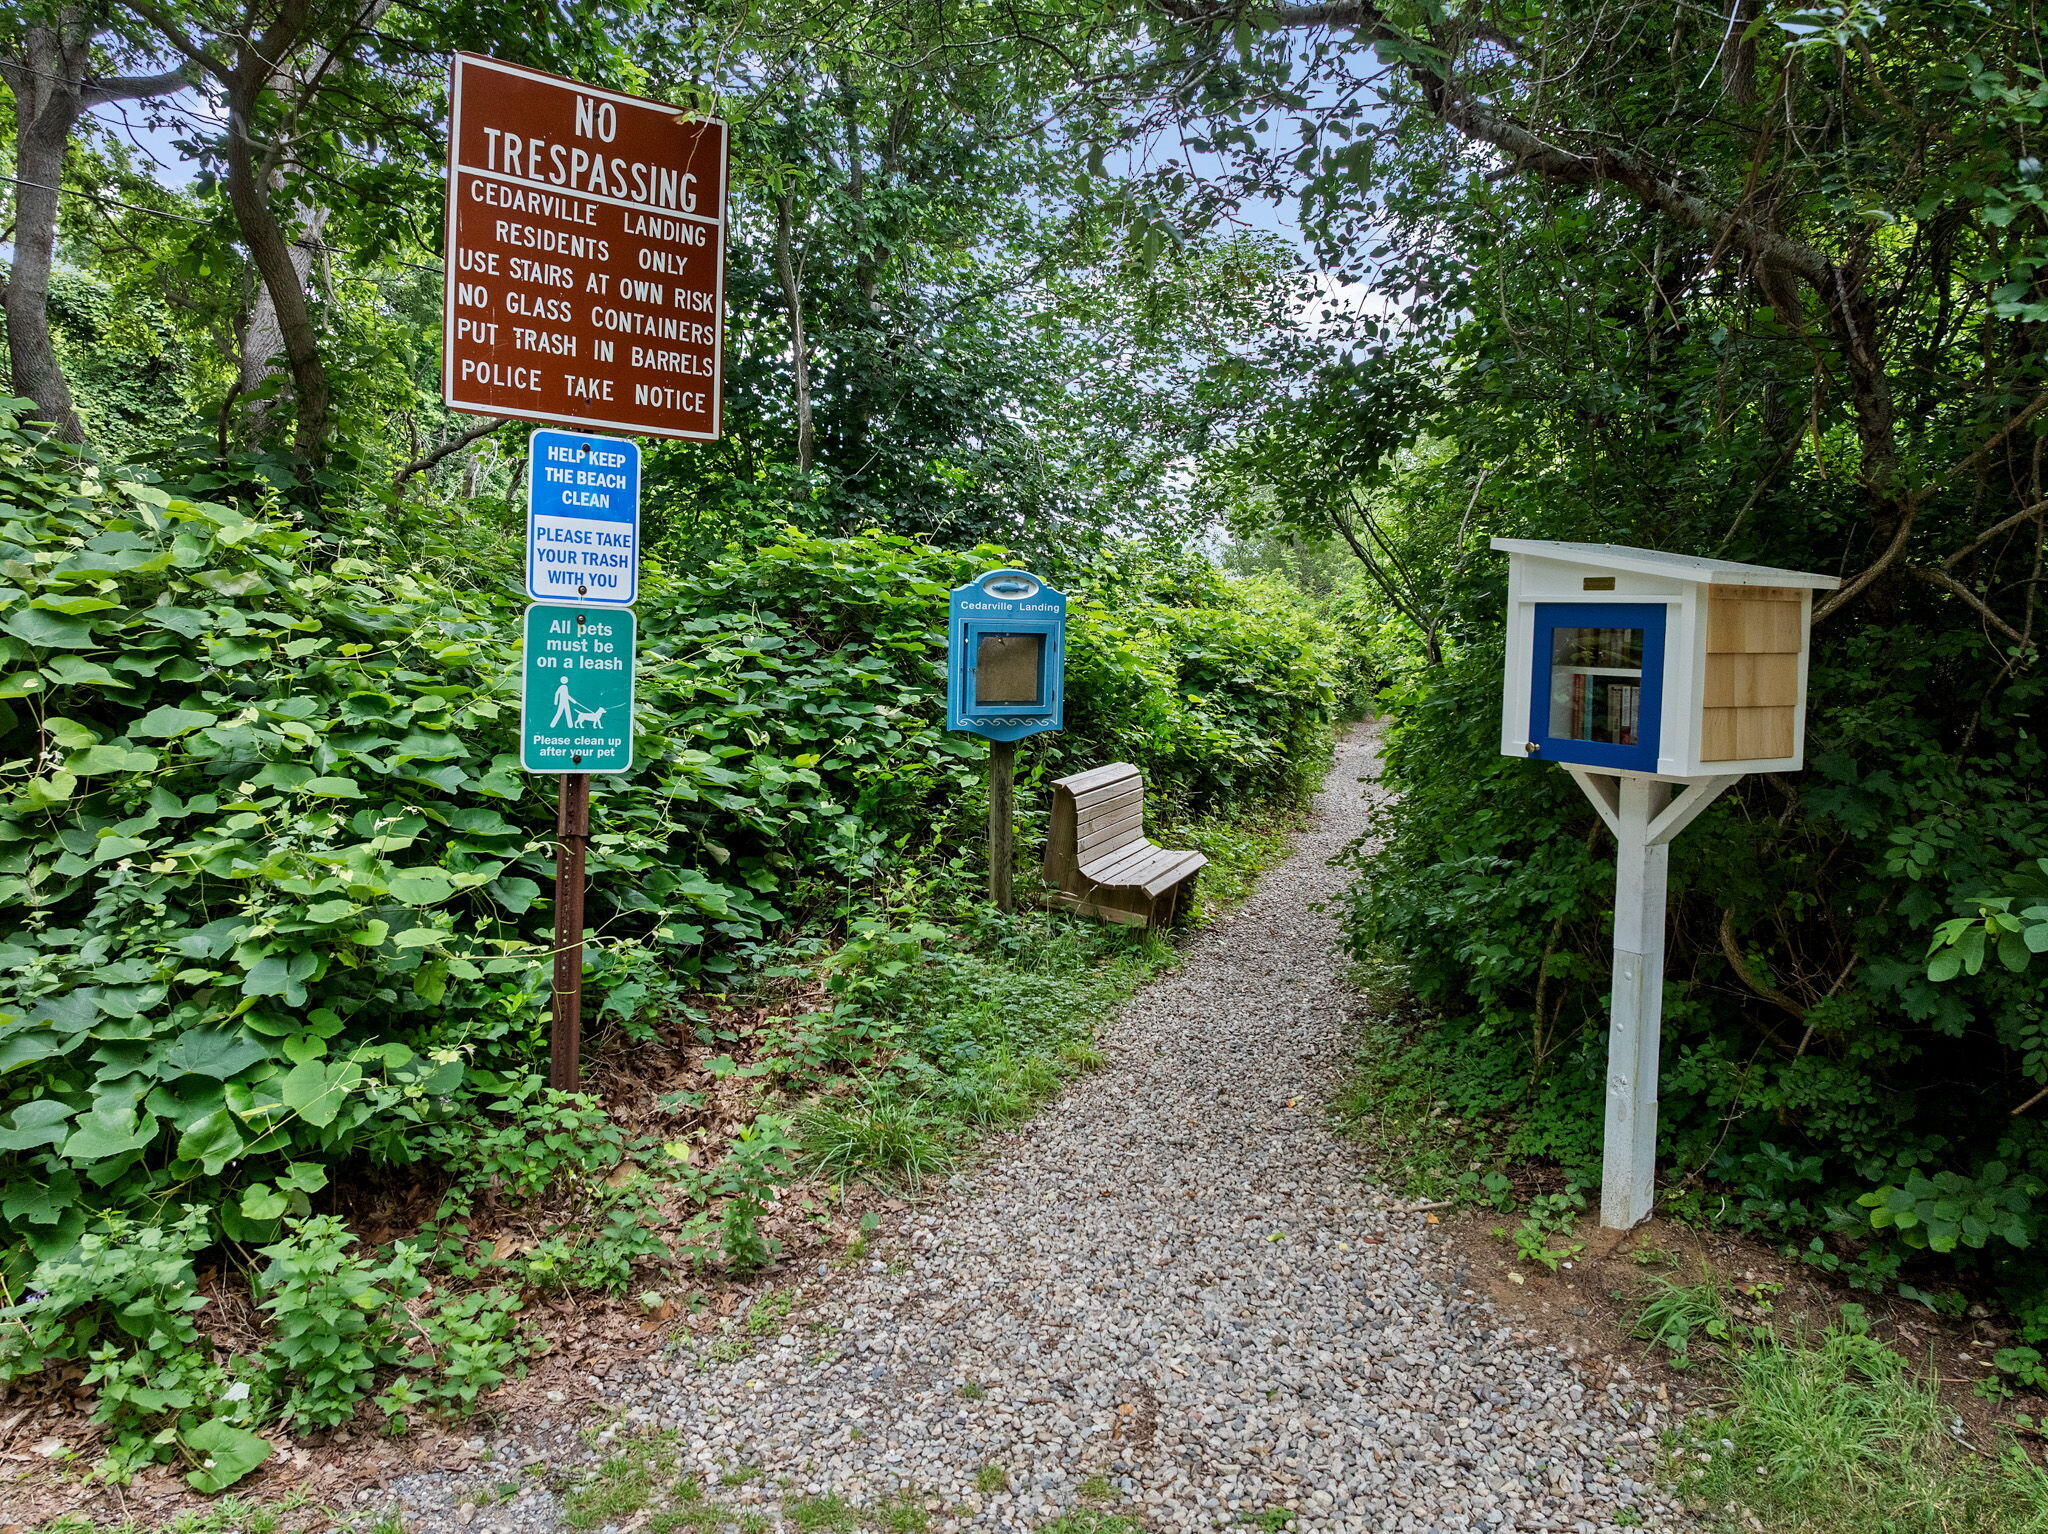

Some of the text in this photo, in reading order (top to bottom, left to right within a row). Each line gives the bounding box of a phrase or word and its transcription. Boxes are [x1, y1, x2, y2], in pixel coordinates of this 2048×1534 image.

[575, 95, 617, 143] NO
[483, 127, 698, 213] TRESPASSING
[471, 179, 707, 248] CEDARVILLE LANDING
[496, 220, 689, 276] RESIDENTS ONLY
[459, 247, 714, 314] USE STAIRS AT OWN RISK
[458, 283, 714, 347] NO GLASS CONTAINERS
[457, 318, 713, 378] PUT TRASH IN BARRELS
[462, 358, 706, 414] POLICE TAKE NOTICE
[547, 445, 626, 468] HELP KEEP
[545, 467, 627, 490] THE BEACH
[561, 490, 610, 509] CLEAN
[537, 526, 631, 549] PLEASE TAKE
[537, 548, 629, 569] YOUR TRASH
[547, 569, 617, 588] WITH YOU
[960, 601, 1060, 613] Cedarville Landing
[549, 619, 613, 637] All pets
[546, 639, 614, 653] must be
[536, 656, 623, 671] on a leash
[533, 735, 622, 748] Please clean up
[539, 746, 615, 758] after your pet
